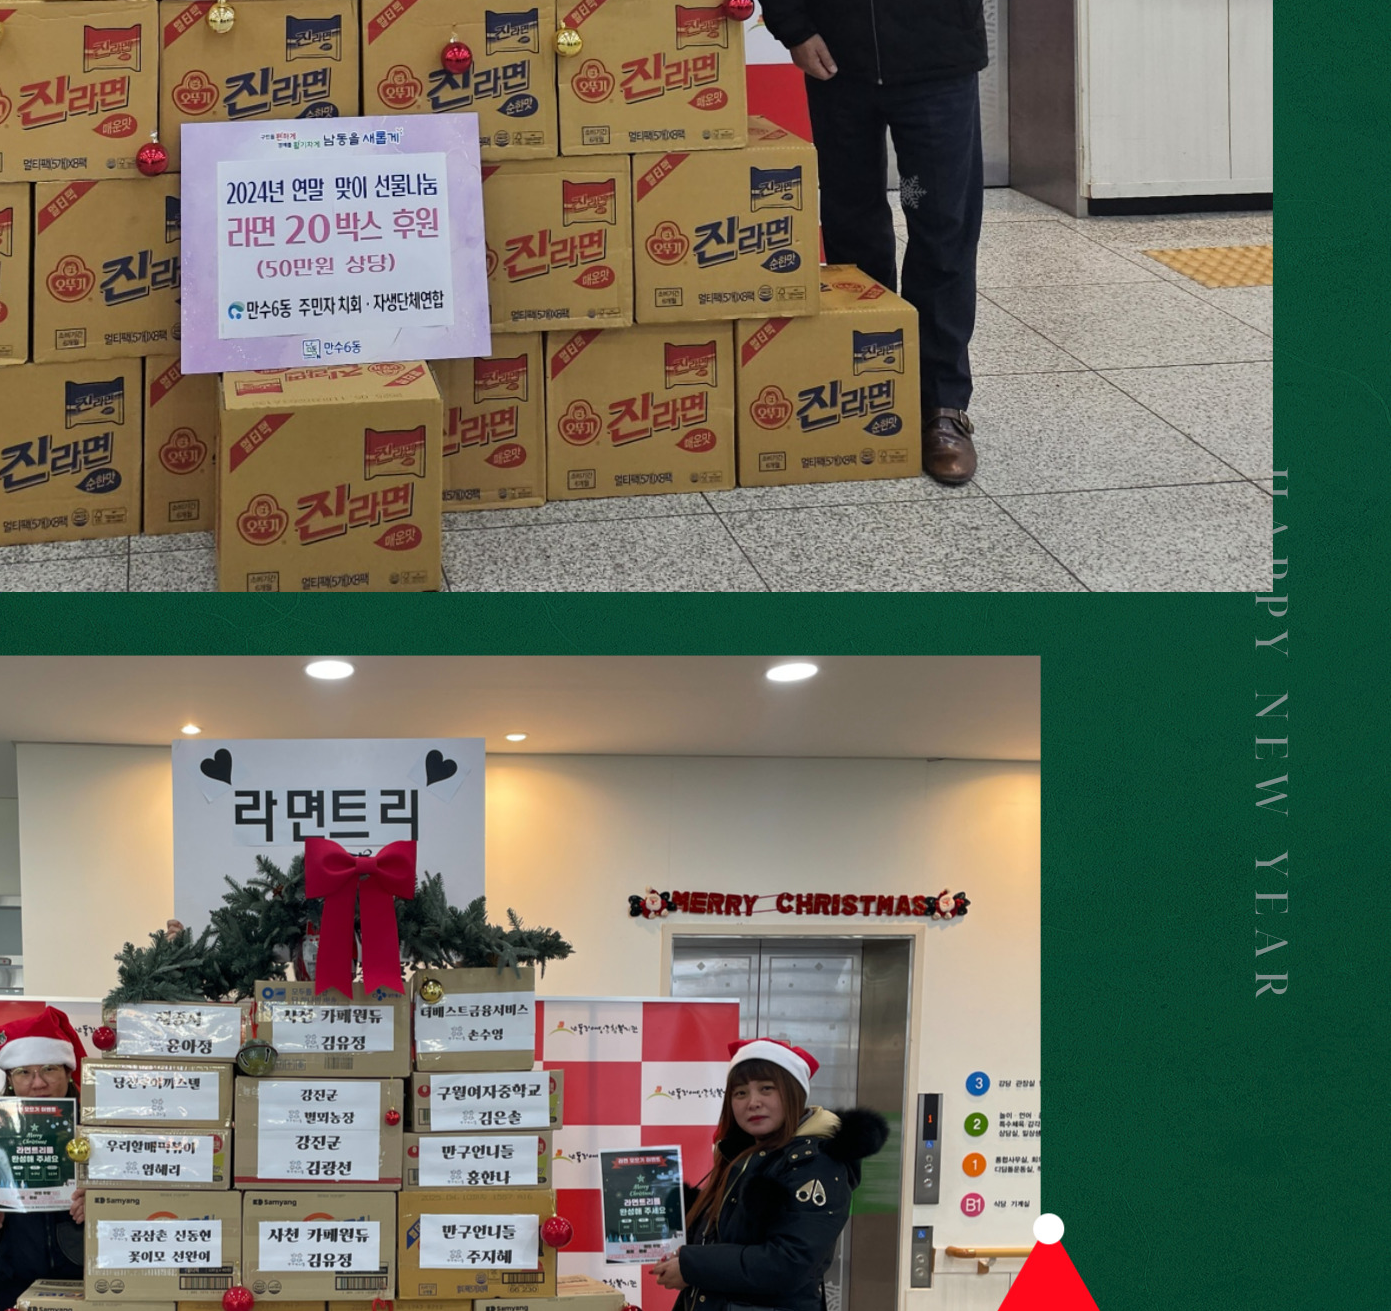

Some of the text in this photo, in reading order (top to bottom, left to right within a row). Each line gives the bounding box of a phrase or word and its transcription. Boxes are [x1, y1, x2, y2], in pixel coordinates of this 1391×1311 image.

[17, 73, 129, 126] 진라면
[323, 130, 401, 147] 남동을 새롭게
[227, 172, 439, 205] 2024년 연말 맞이 선물나눔
[227, 207, 440, 248] 라면 20 박스 후원
[257, 253, 397, 279] (50만원 상당)
[247, 297, 292, 320] 만수6동
[323, 339, 362, 355] 만수6동
[797, 380, 896, 431] 진라면
[609, 392, 708, 445] 진라면
[0, 432, 114, 493] 진라면
[294, 482, 414, 545] 진라면
[246, 517, 281, 534] 오뚜기
[234, 788, 419, 843] 라면트리
[673, 891, 927, 917] MERRY CHRISTMAS
[321, 1008, 382, 1024] 카페원듀
[419, 999, 528, 1019] 더베스트금융서비스
[322, 1035, 366, 1051] 김유정
[467, 1028, 504, 1042] 손수영
[975, 1077, 984, 1089] 3
[301, 1088, 337, 1102] 강진군
[437, 1083, 541, 1101] 구월여자중학교
[479, 1109, 521, 1126] 김은솔
[973, 1118, 982, 1130] 2
[296, 1134, 341, 1151] 강진군
[441, 1144, 514, 1160] 만구언니들
[307, 1160, 352, 1176] 김광선
[467, 1169, 510, 1186] 홍한나
[106, 1197, 140, 1206] Samyang
[263, 1198, 298, 1207] Samyang
[965, 1198, 982, 1212] B1
[268, 1227, 368, 1243] 사천 카페원듀
[442, 1224, 515, 1240] 만구언니들
[308, 1252, 353, 1268] 김유정
[467, 1249, 513, 1265] 주지혜
